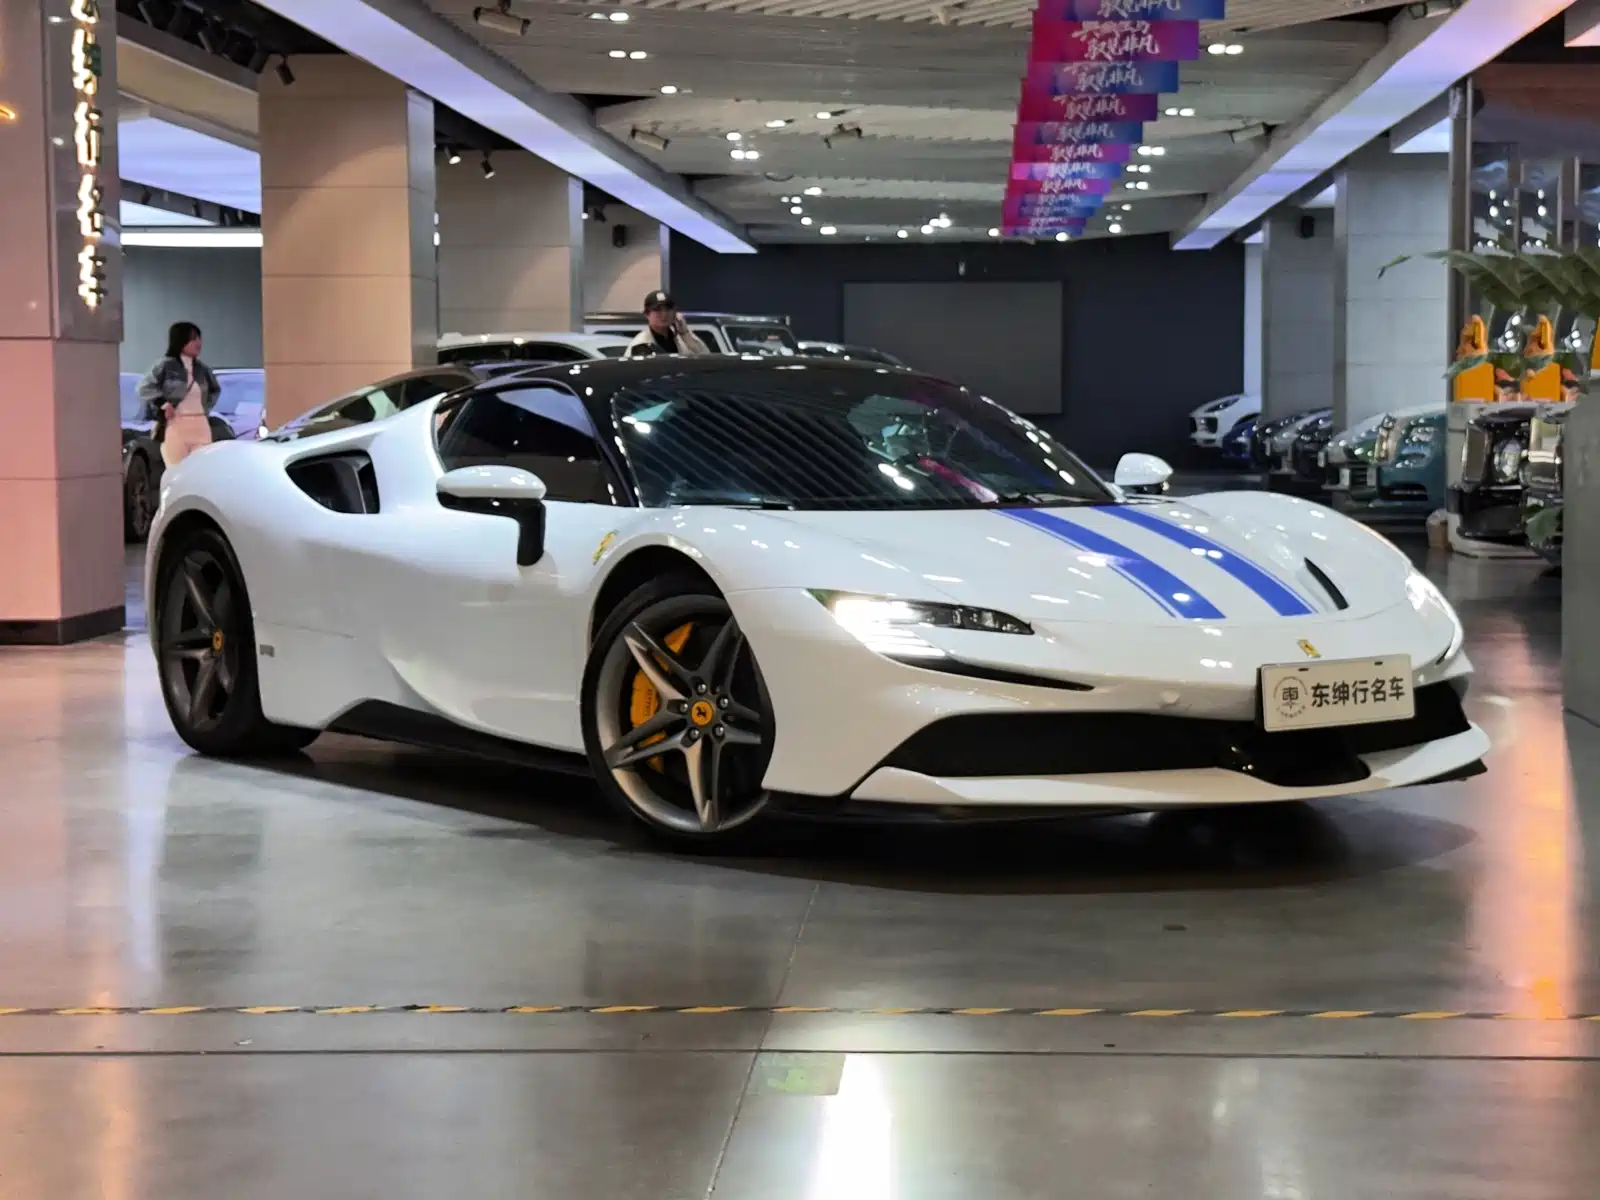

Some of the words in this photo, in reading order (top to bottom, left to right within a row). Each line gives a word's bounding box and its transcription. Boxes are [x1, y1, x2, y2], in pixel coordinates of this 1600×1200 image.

[1311, 676, 1405, 708] 东绅行名车
